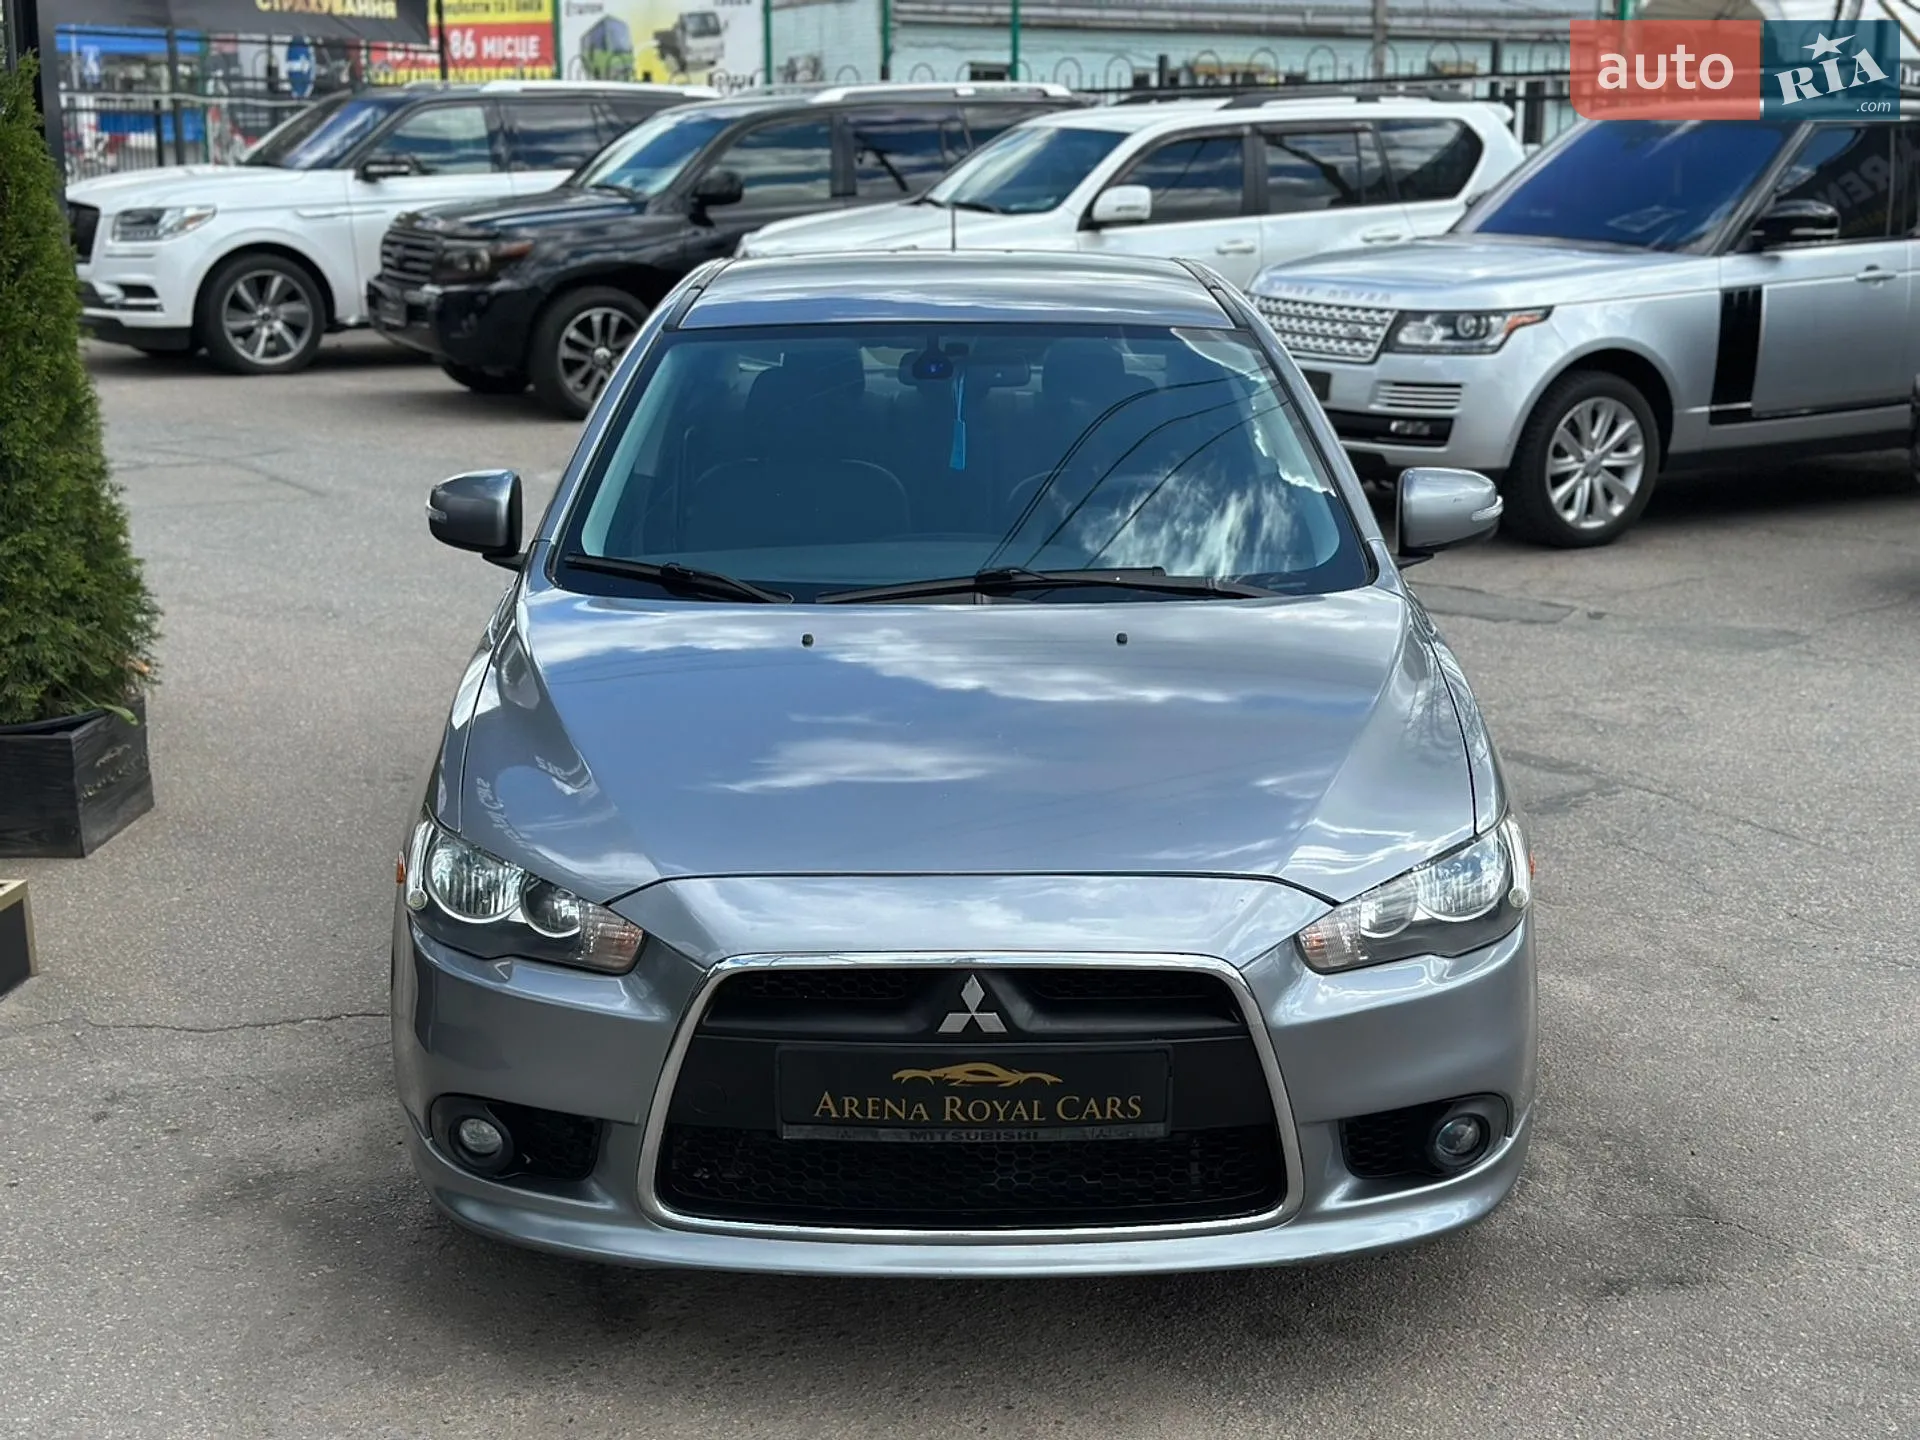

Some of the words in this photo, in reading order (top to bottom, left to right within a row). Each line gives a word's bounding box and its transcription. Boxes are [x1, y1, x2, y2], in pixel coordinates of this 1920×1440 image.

[450, 29, 476, 60] 86
[1056, 1095, 1143, 1120] CARS
[909, 1130, 1039, 1142] MITSUBISHI
